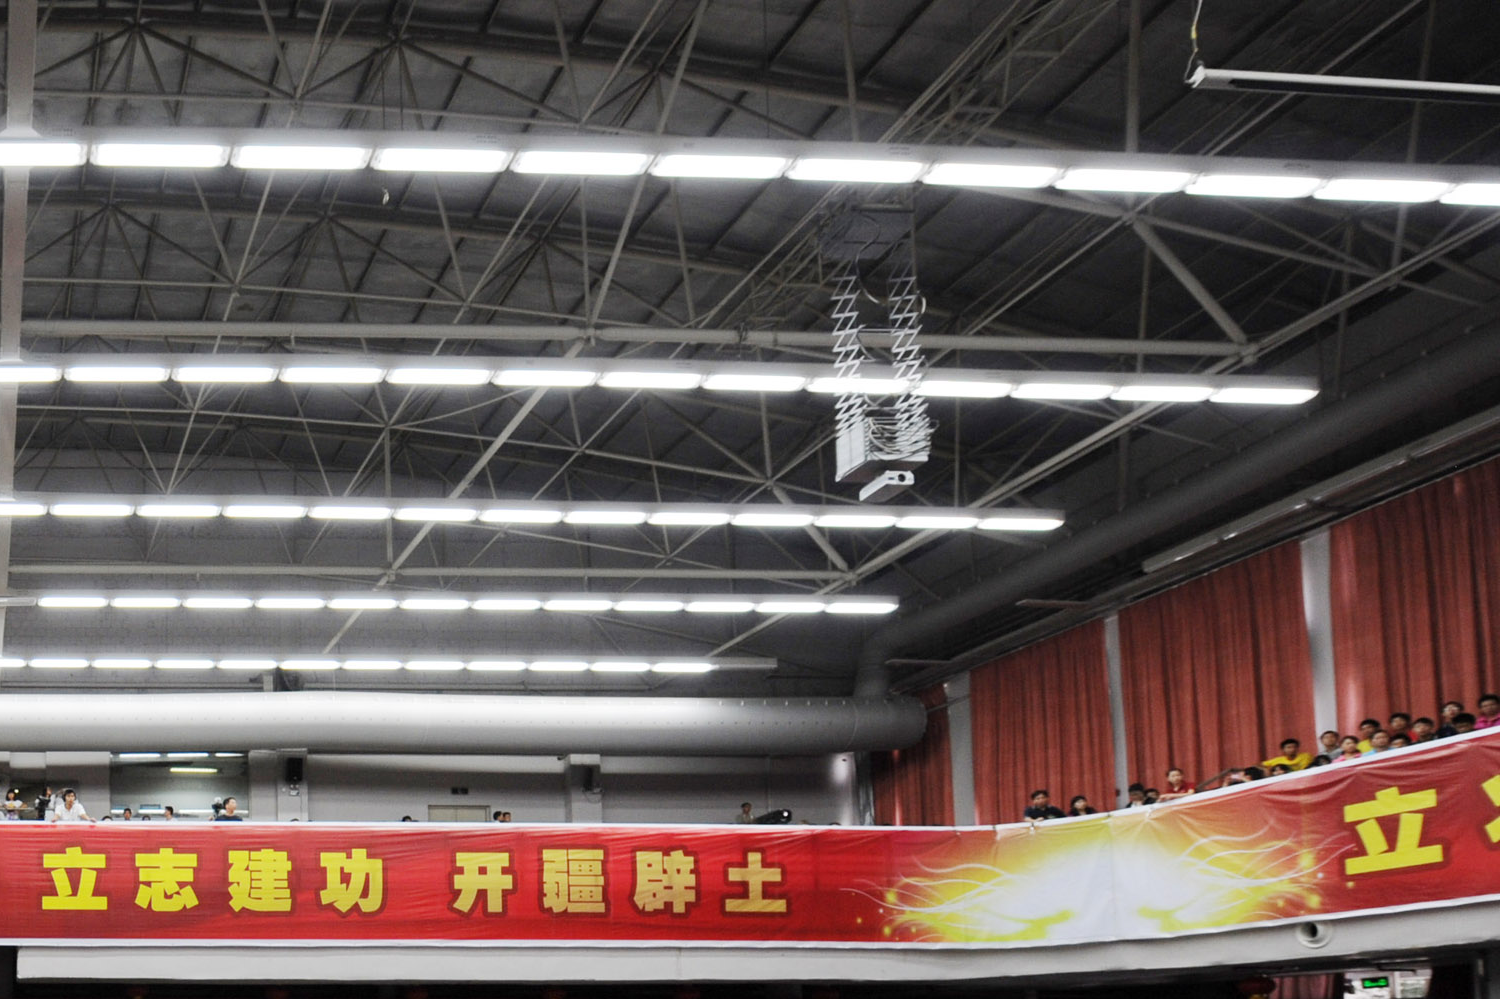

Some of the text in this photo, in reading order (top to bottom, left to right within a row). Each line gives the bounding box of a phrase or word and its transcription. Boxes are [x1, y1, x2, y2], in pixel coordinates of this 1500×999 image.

[43, 847, 385, 914] 立志建功
[455, 849, 787, 913] 开疆辟土
